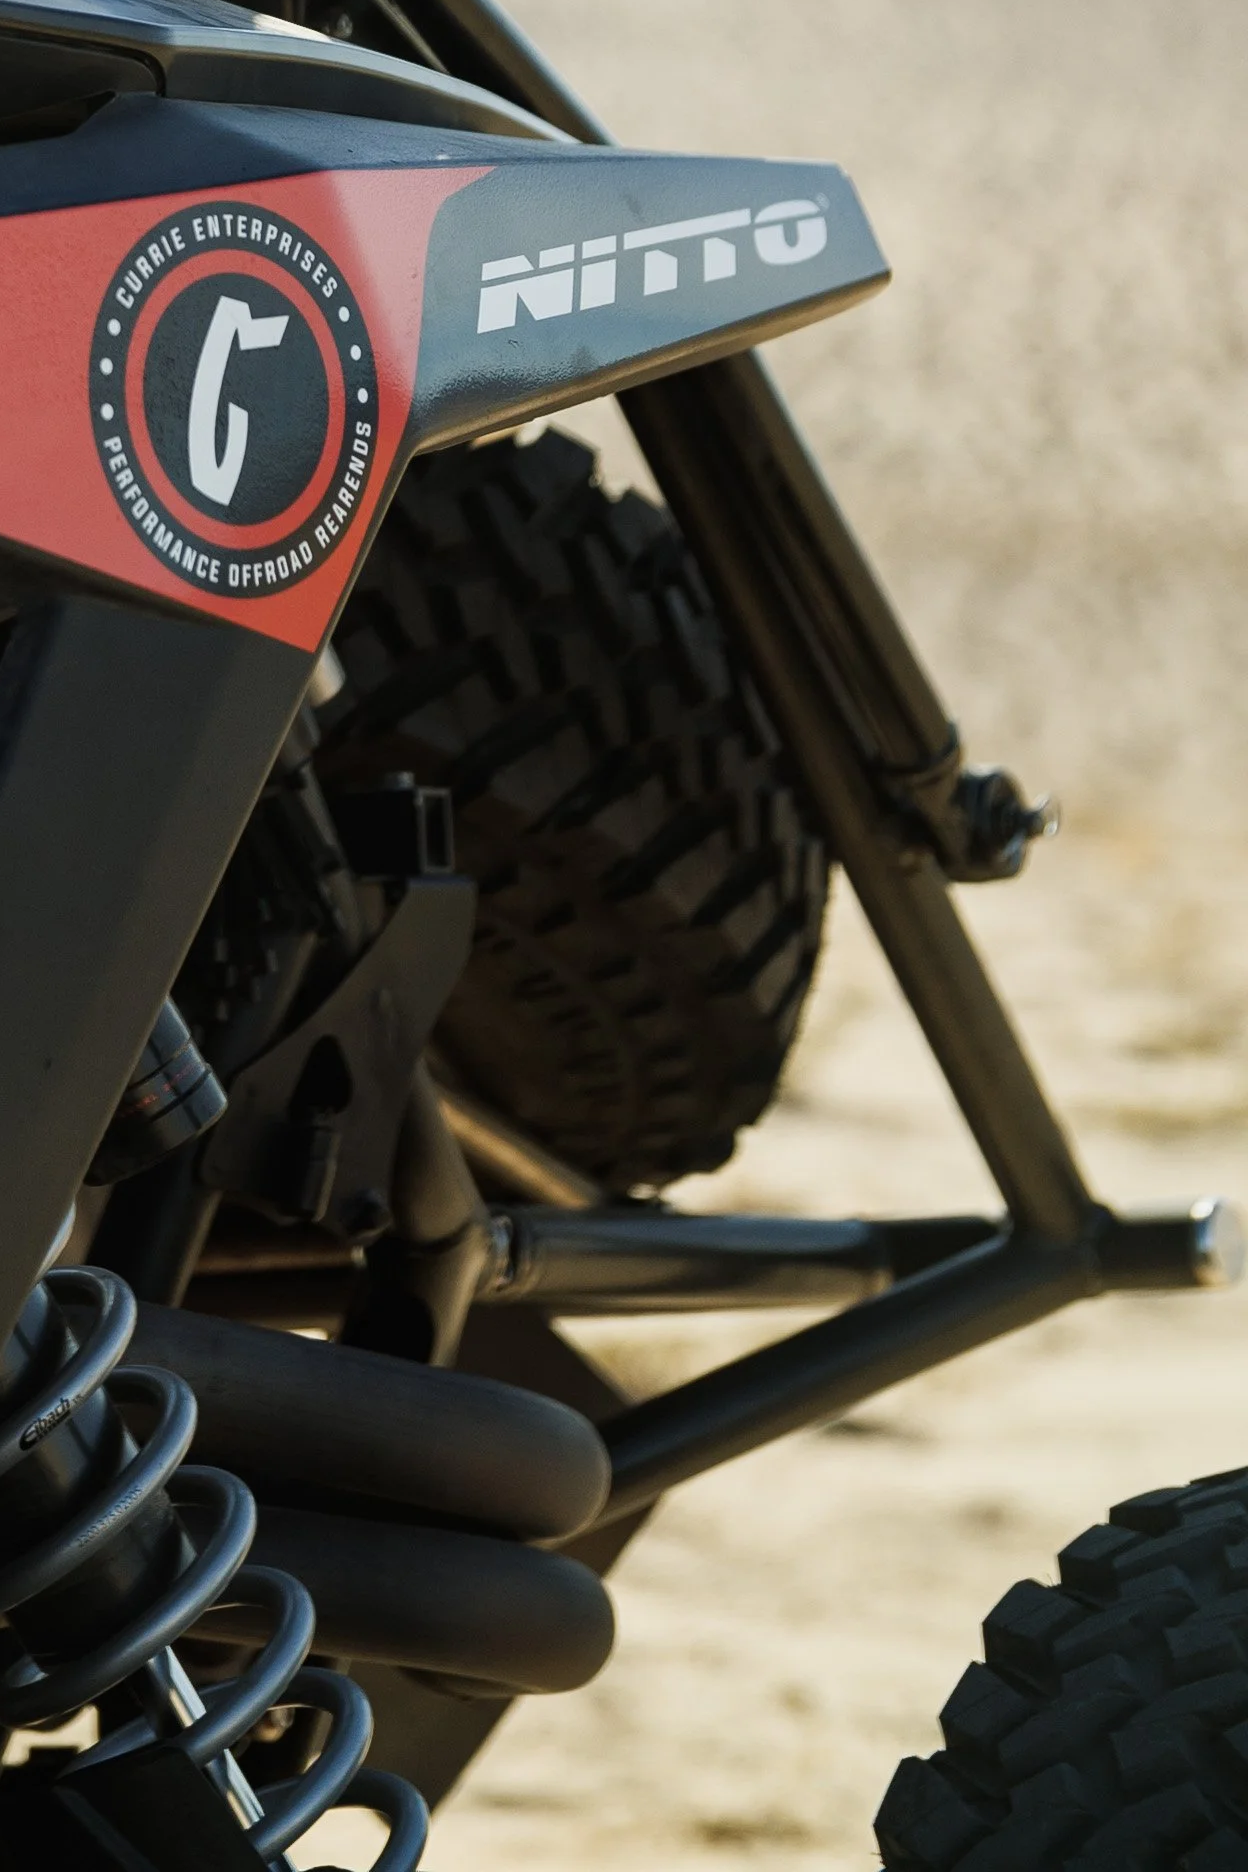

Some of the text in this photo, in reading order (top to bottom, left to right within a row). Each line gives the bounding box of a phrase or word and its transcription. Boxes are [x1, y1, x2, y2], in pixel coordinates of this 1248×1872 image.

[116, 213, 339, 309] CURRIE ENTERPRISES
[477, 198, 828, 334] NITTO
[103, 420, 372, 588] PERFORMANCE OFFROAD REARENDS
[19, 1396, 71, 1451] Eibach
